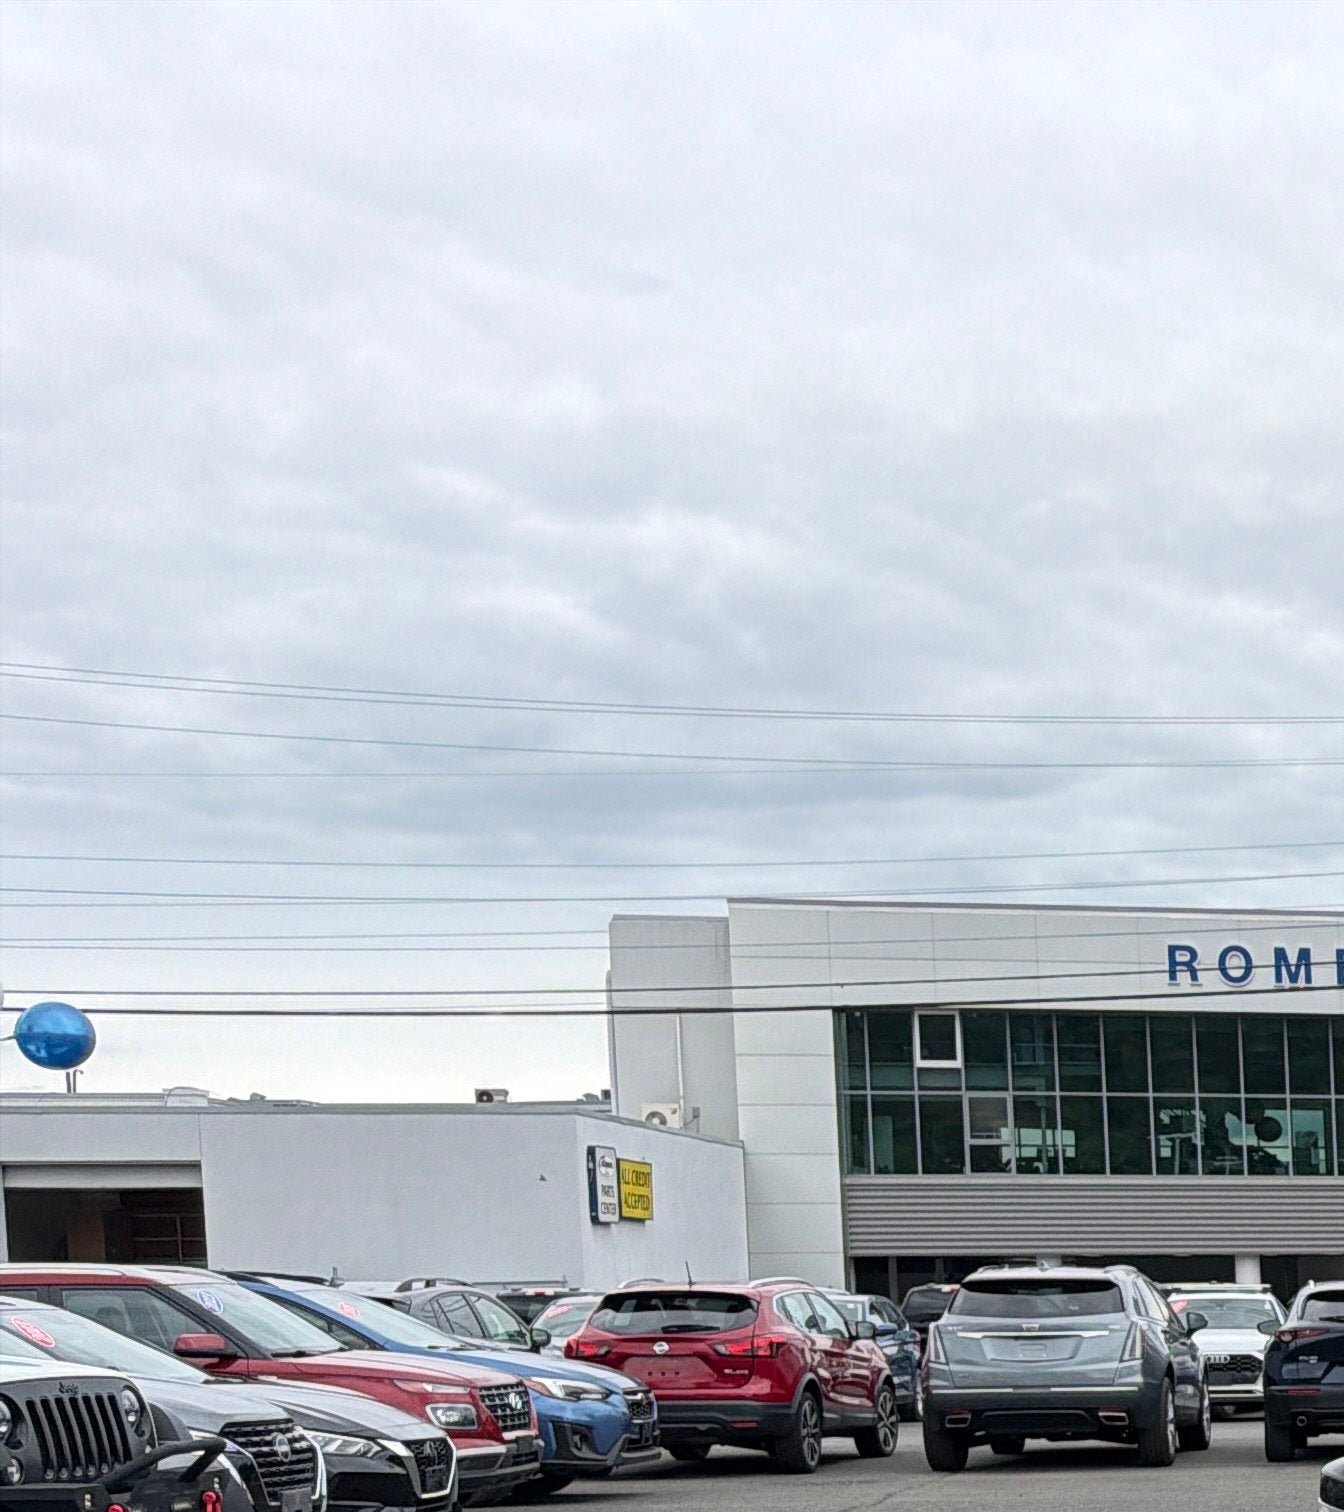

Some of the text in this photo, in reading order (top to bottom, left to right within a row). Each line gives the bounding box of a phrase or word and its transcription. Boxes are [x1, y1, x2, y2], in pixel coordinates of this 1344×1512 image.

[621, 1168, 651, 1189] ALL CREDIT
[624, 1192, 651, 1211] ACCEPTED
